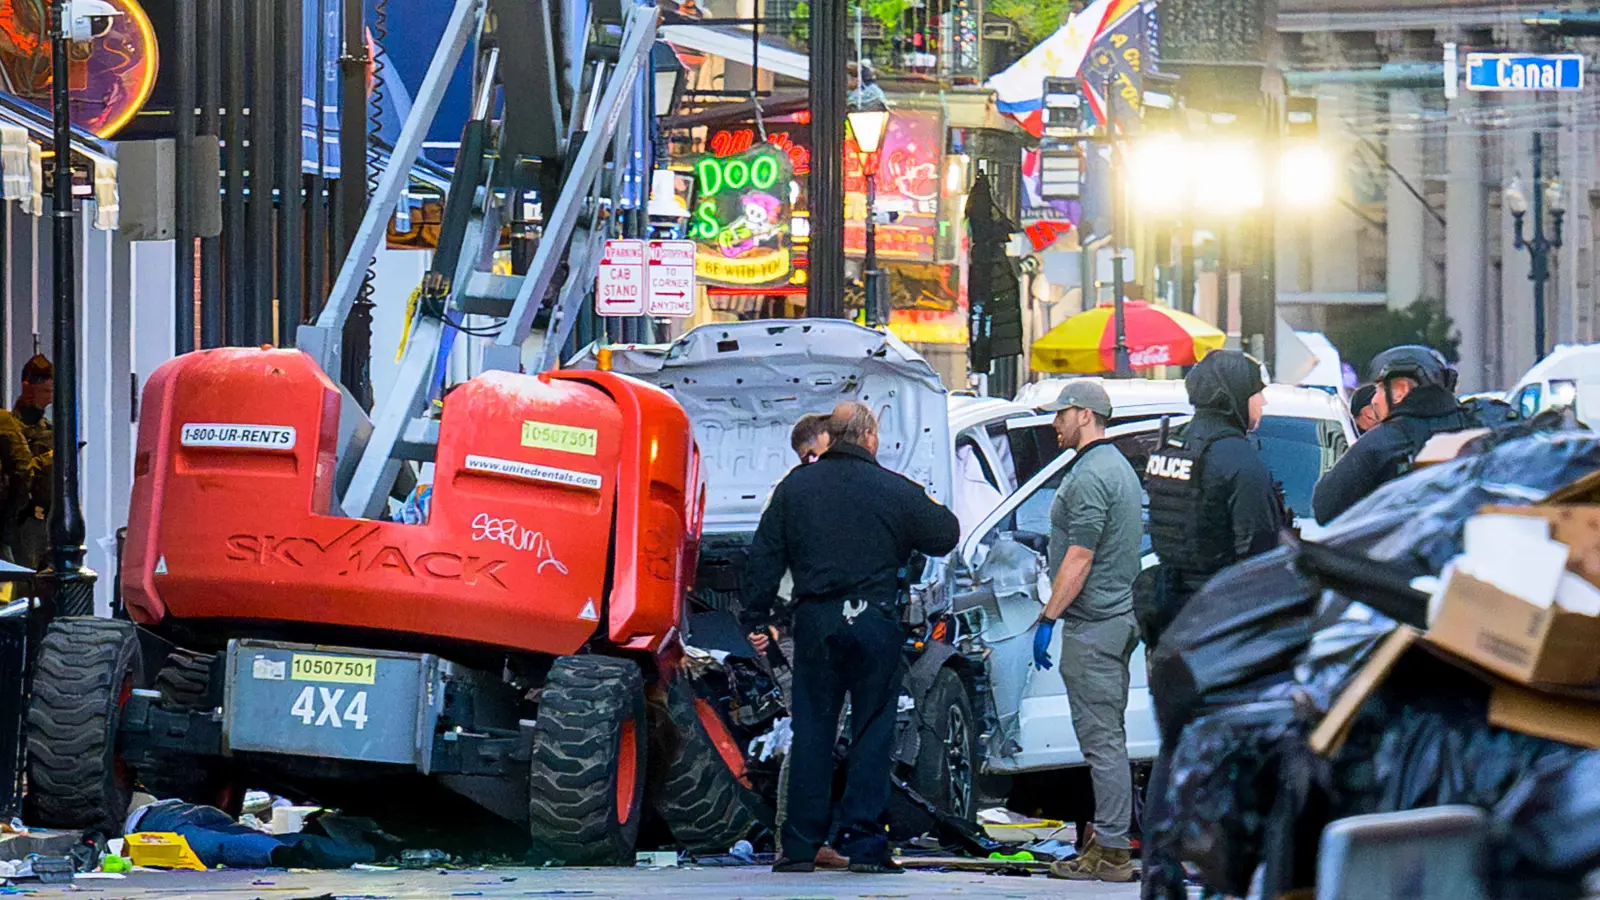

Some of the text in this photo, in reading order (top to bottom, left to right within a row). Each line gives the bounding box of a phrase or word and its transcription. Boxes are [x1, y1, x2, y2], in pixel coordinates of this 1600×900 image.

[1496, 59, 1562, 88] Canal
[610, 268, 631, 280] CAB
[666, 267, 677, 276] TO
[705, 261, 720, 275] BE
[724, 264, 755, 278] WITH
[603, 284, 637, 297] STAND
[652, 278, 689, 287] CORNER
[650, 301, 690, 311] ANYTIME
[184, 428, 290, 444] 1-800-UR-RENTS
[523, 422, 595, 448] 10507501
[468, 459, 598, 486] www.unitedrentals.com
[226, 523, 509, 590] SKYJACK
[293, 658, 374, 678] 10507501
[291, 686, 369, 730] 4X4
